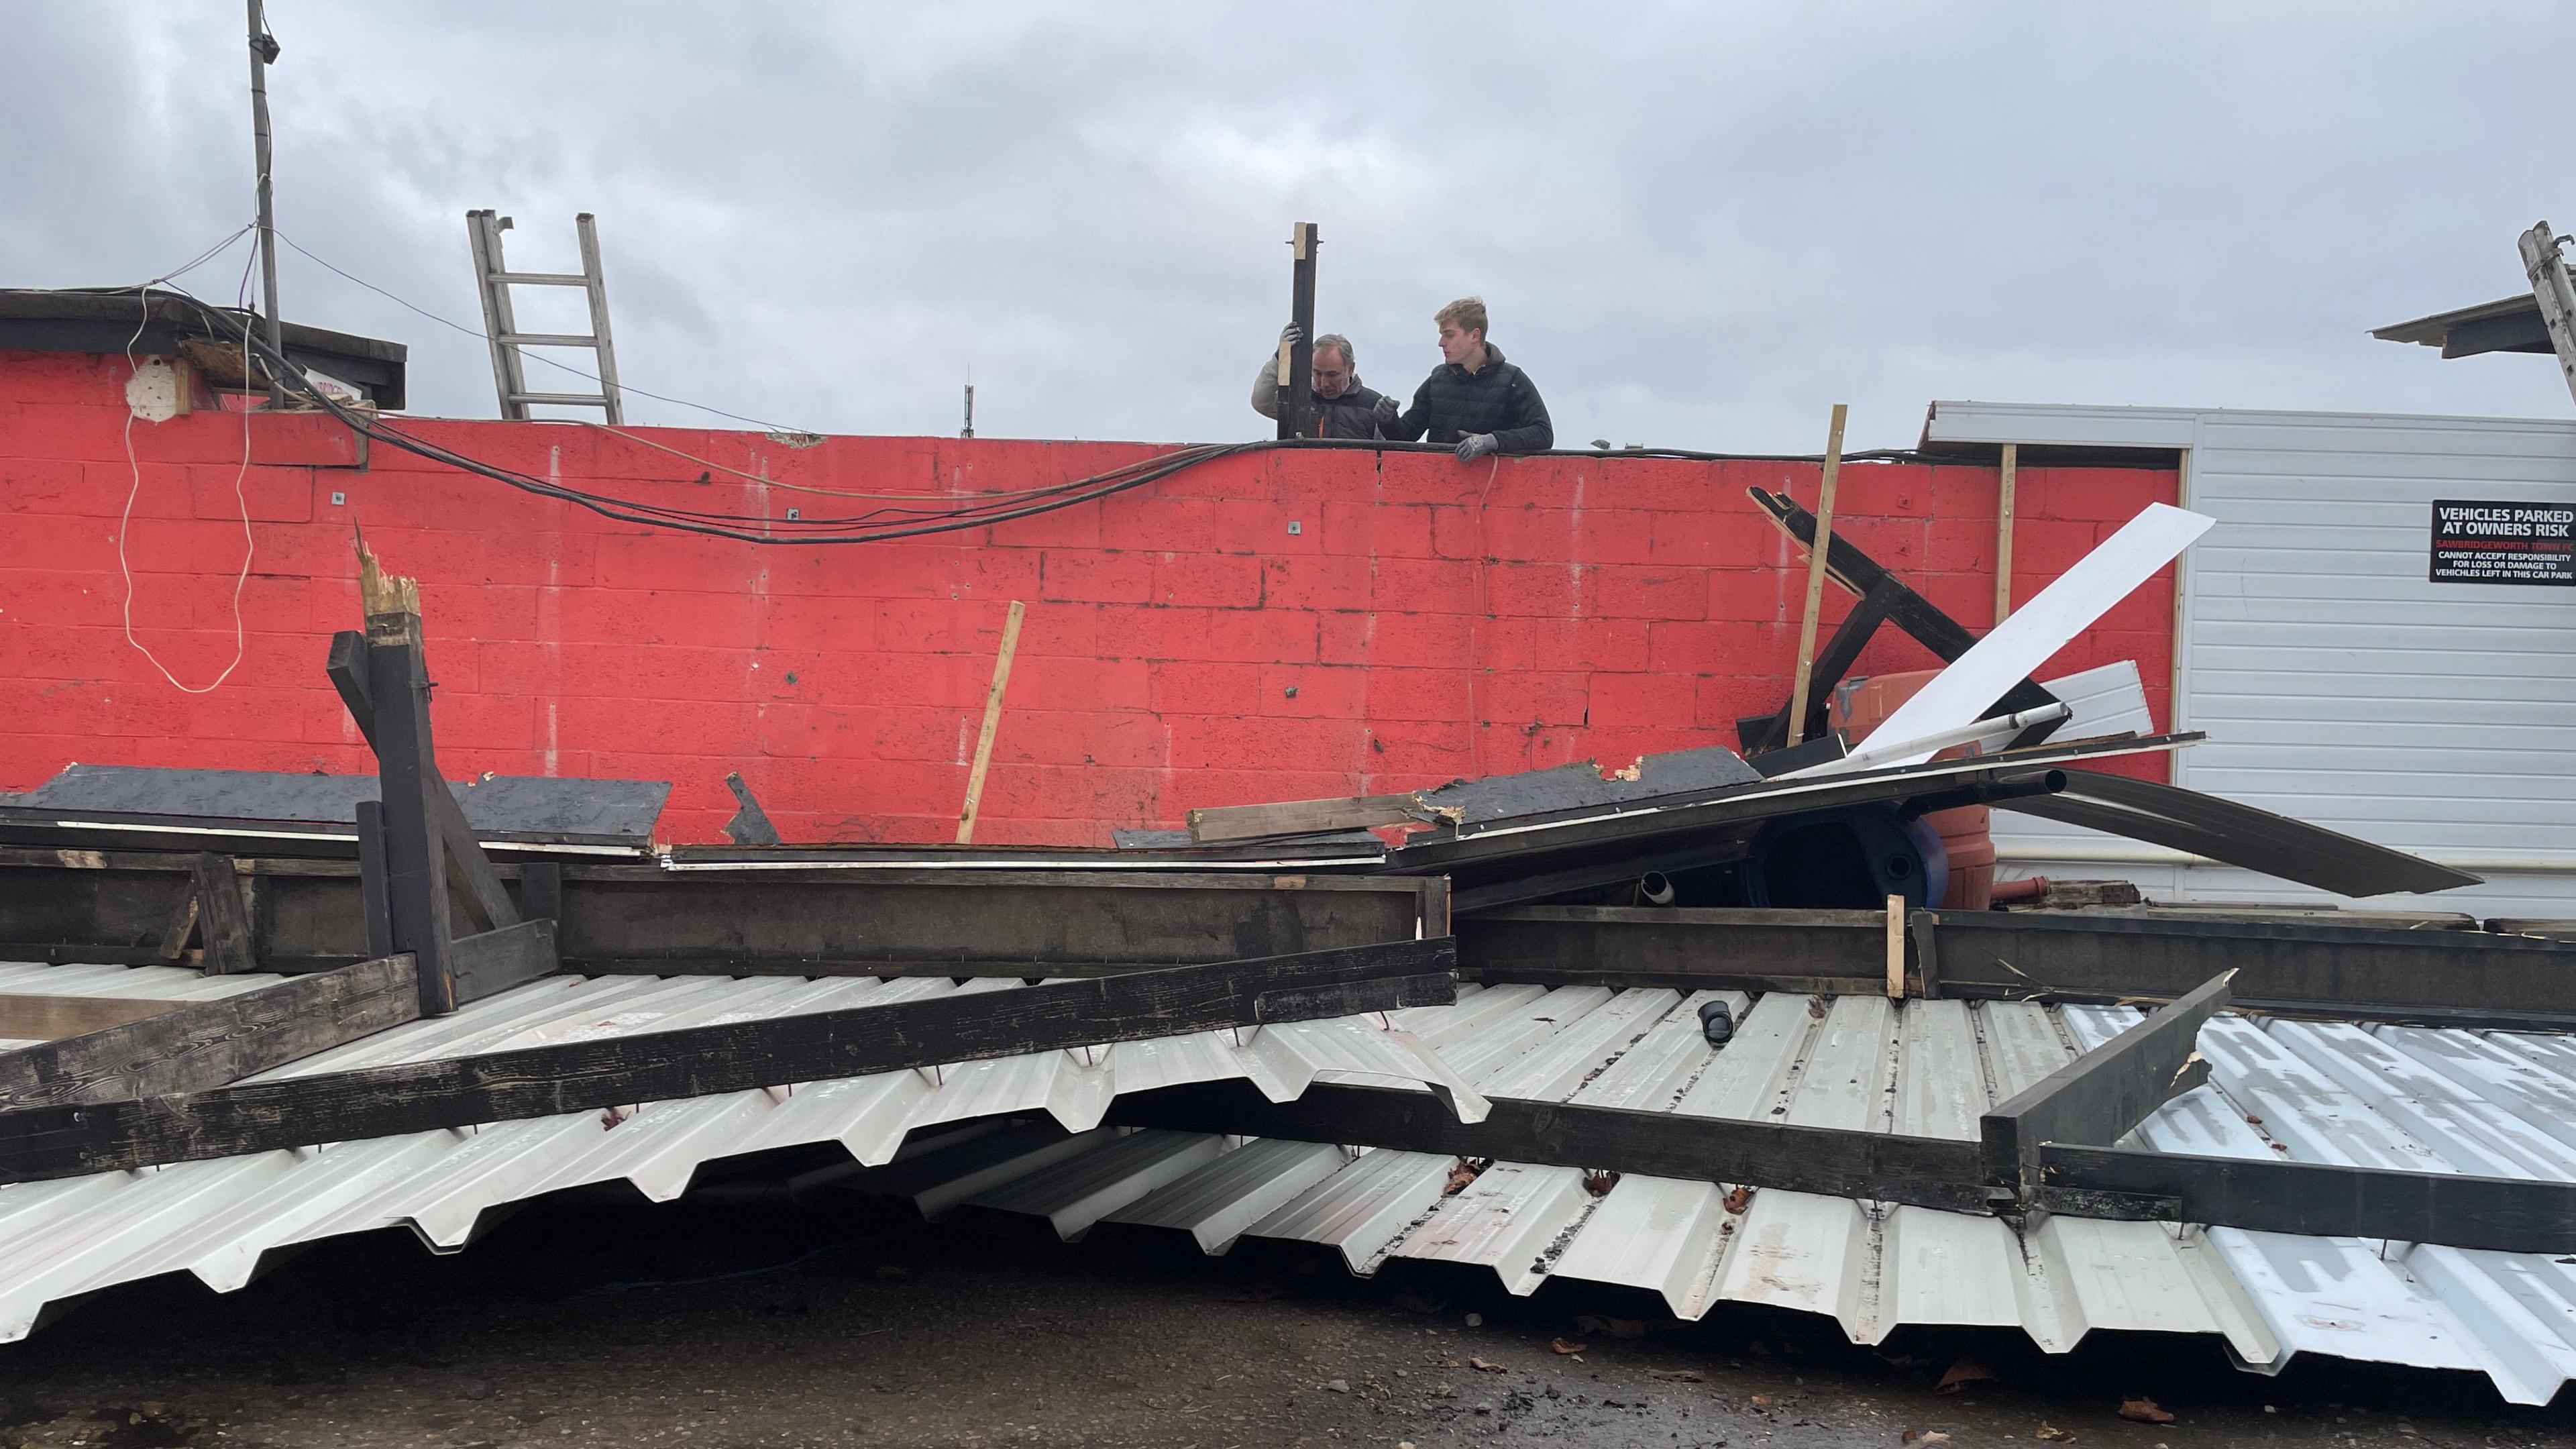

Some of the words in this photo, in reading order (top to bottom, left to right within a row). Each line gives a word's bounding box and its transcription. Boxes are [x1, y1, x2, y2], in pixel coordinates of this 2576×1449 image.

[2439, 508, 2510, 521] VEHICLES
[2514, 510, 2574, 523] PARKED
[2443, 522, 2463, 534] AT
[2466, 522, 2531, 536] OWNERS
[2536, 525, 2569, 537] RISK
[2436, 540, 2528, 549] SAWBRIDGEWORTH
[2508, 553, 2571, 561] RESPONSIBILITY
